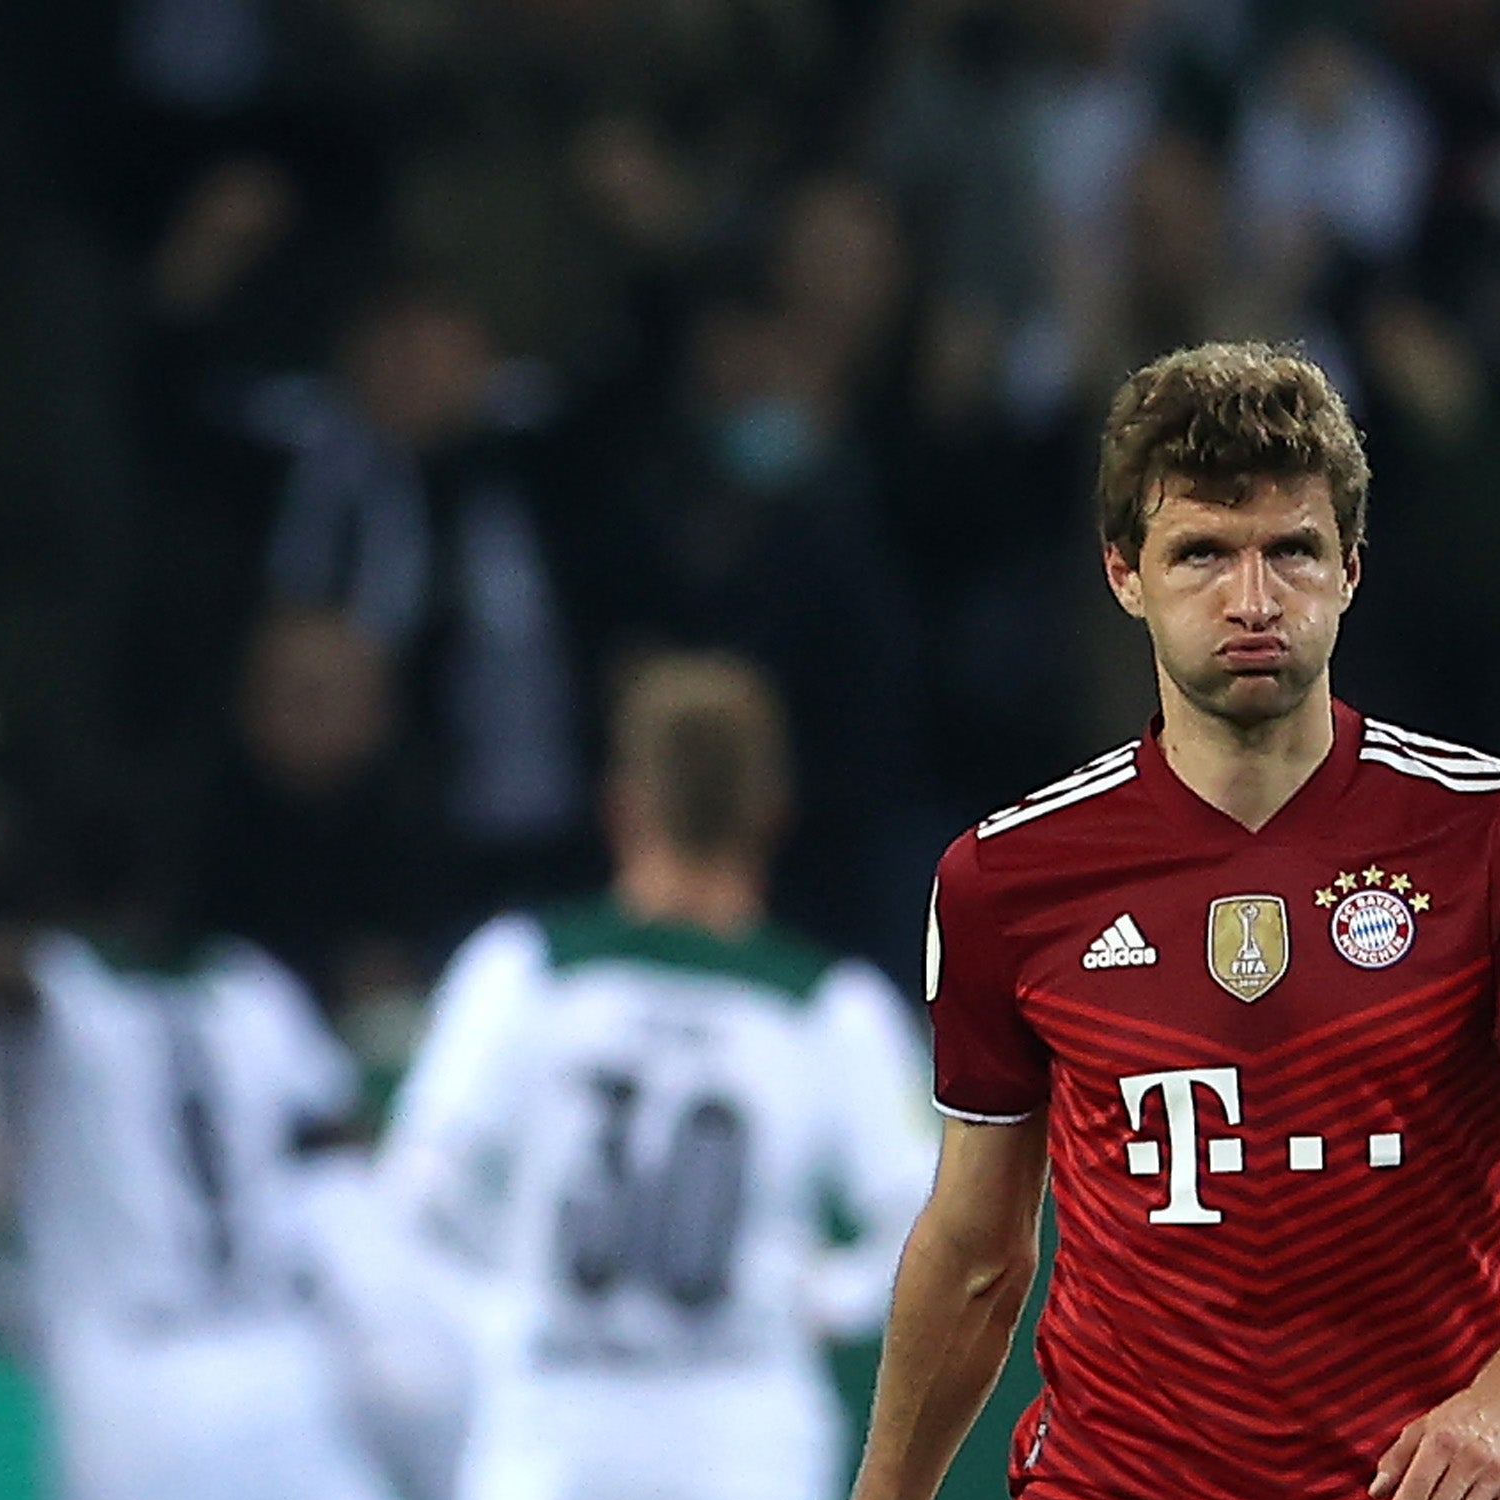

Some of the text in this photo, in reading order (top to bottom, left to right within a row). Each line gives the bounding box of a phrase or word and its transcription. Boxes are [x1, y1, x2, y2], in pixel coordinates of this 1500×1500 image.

[1355, 895, 1407, 926] BAYERN
[1083, 945, 1156, 969] adidas
[1231, 960, 1267, 974] FIFA
